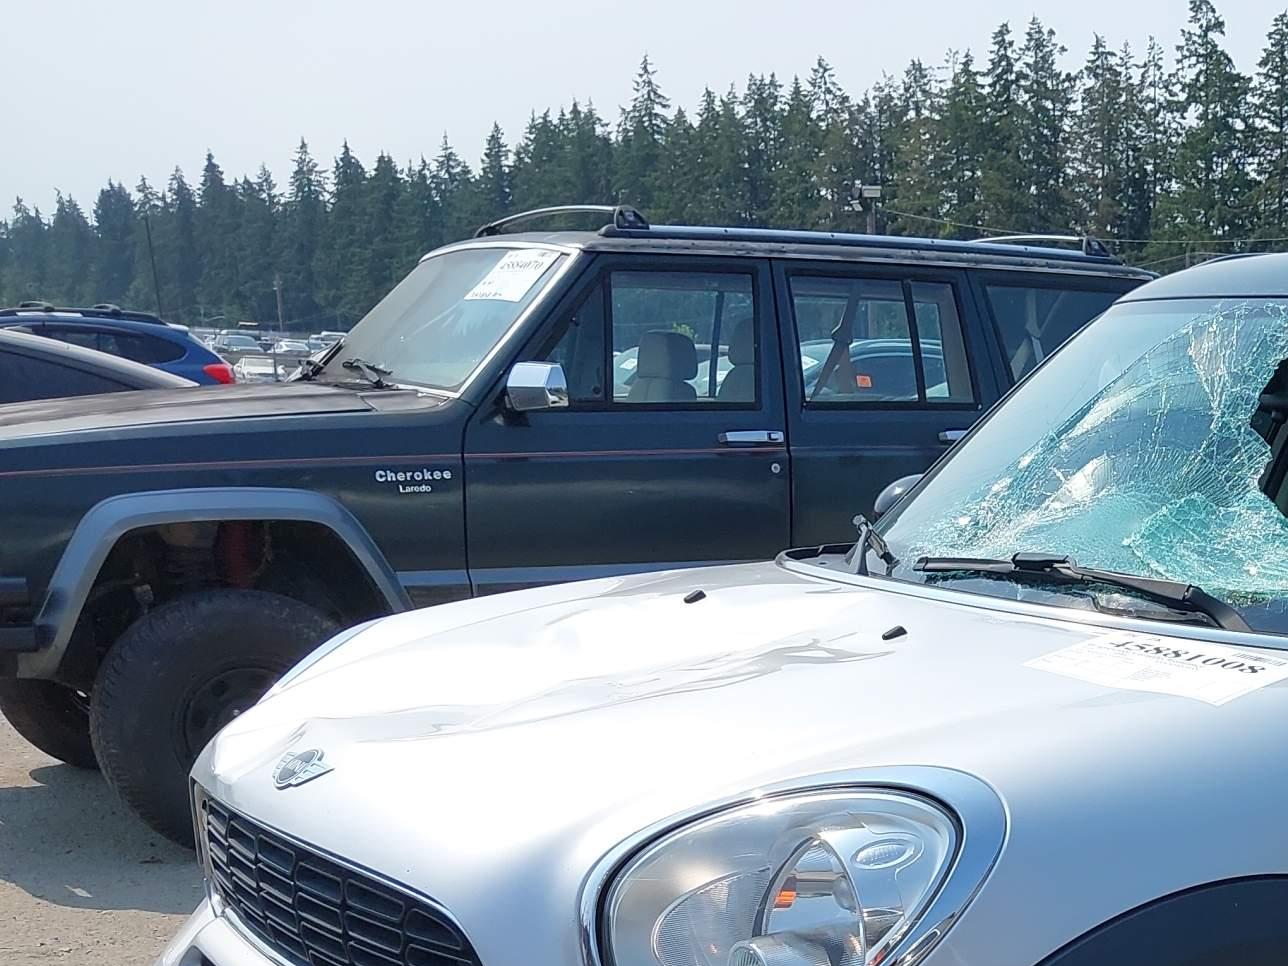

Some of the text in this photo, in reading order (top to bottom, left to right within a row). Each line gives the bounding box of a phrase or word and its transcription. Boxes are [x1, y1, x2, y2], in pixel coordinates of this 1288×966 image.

[375, 468, 453, 482] Cherokee
[398, 483, 432, 493] Laredo
[1109, 639, 1267, 675] 45881008
